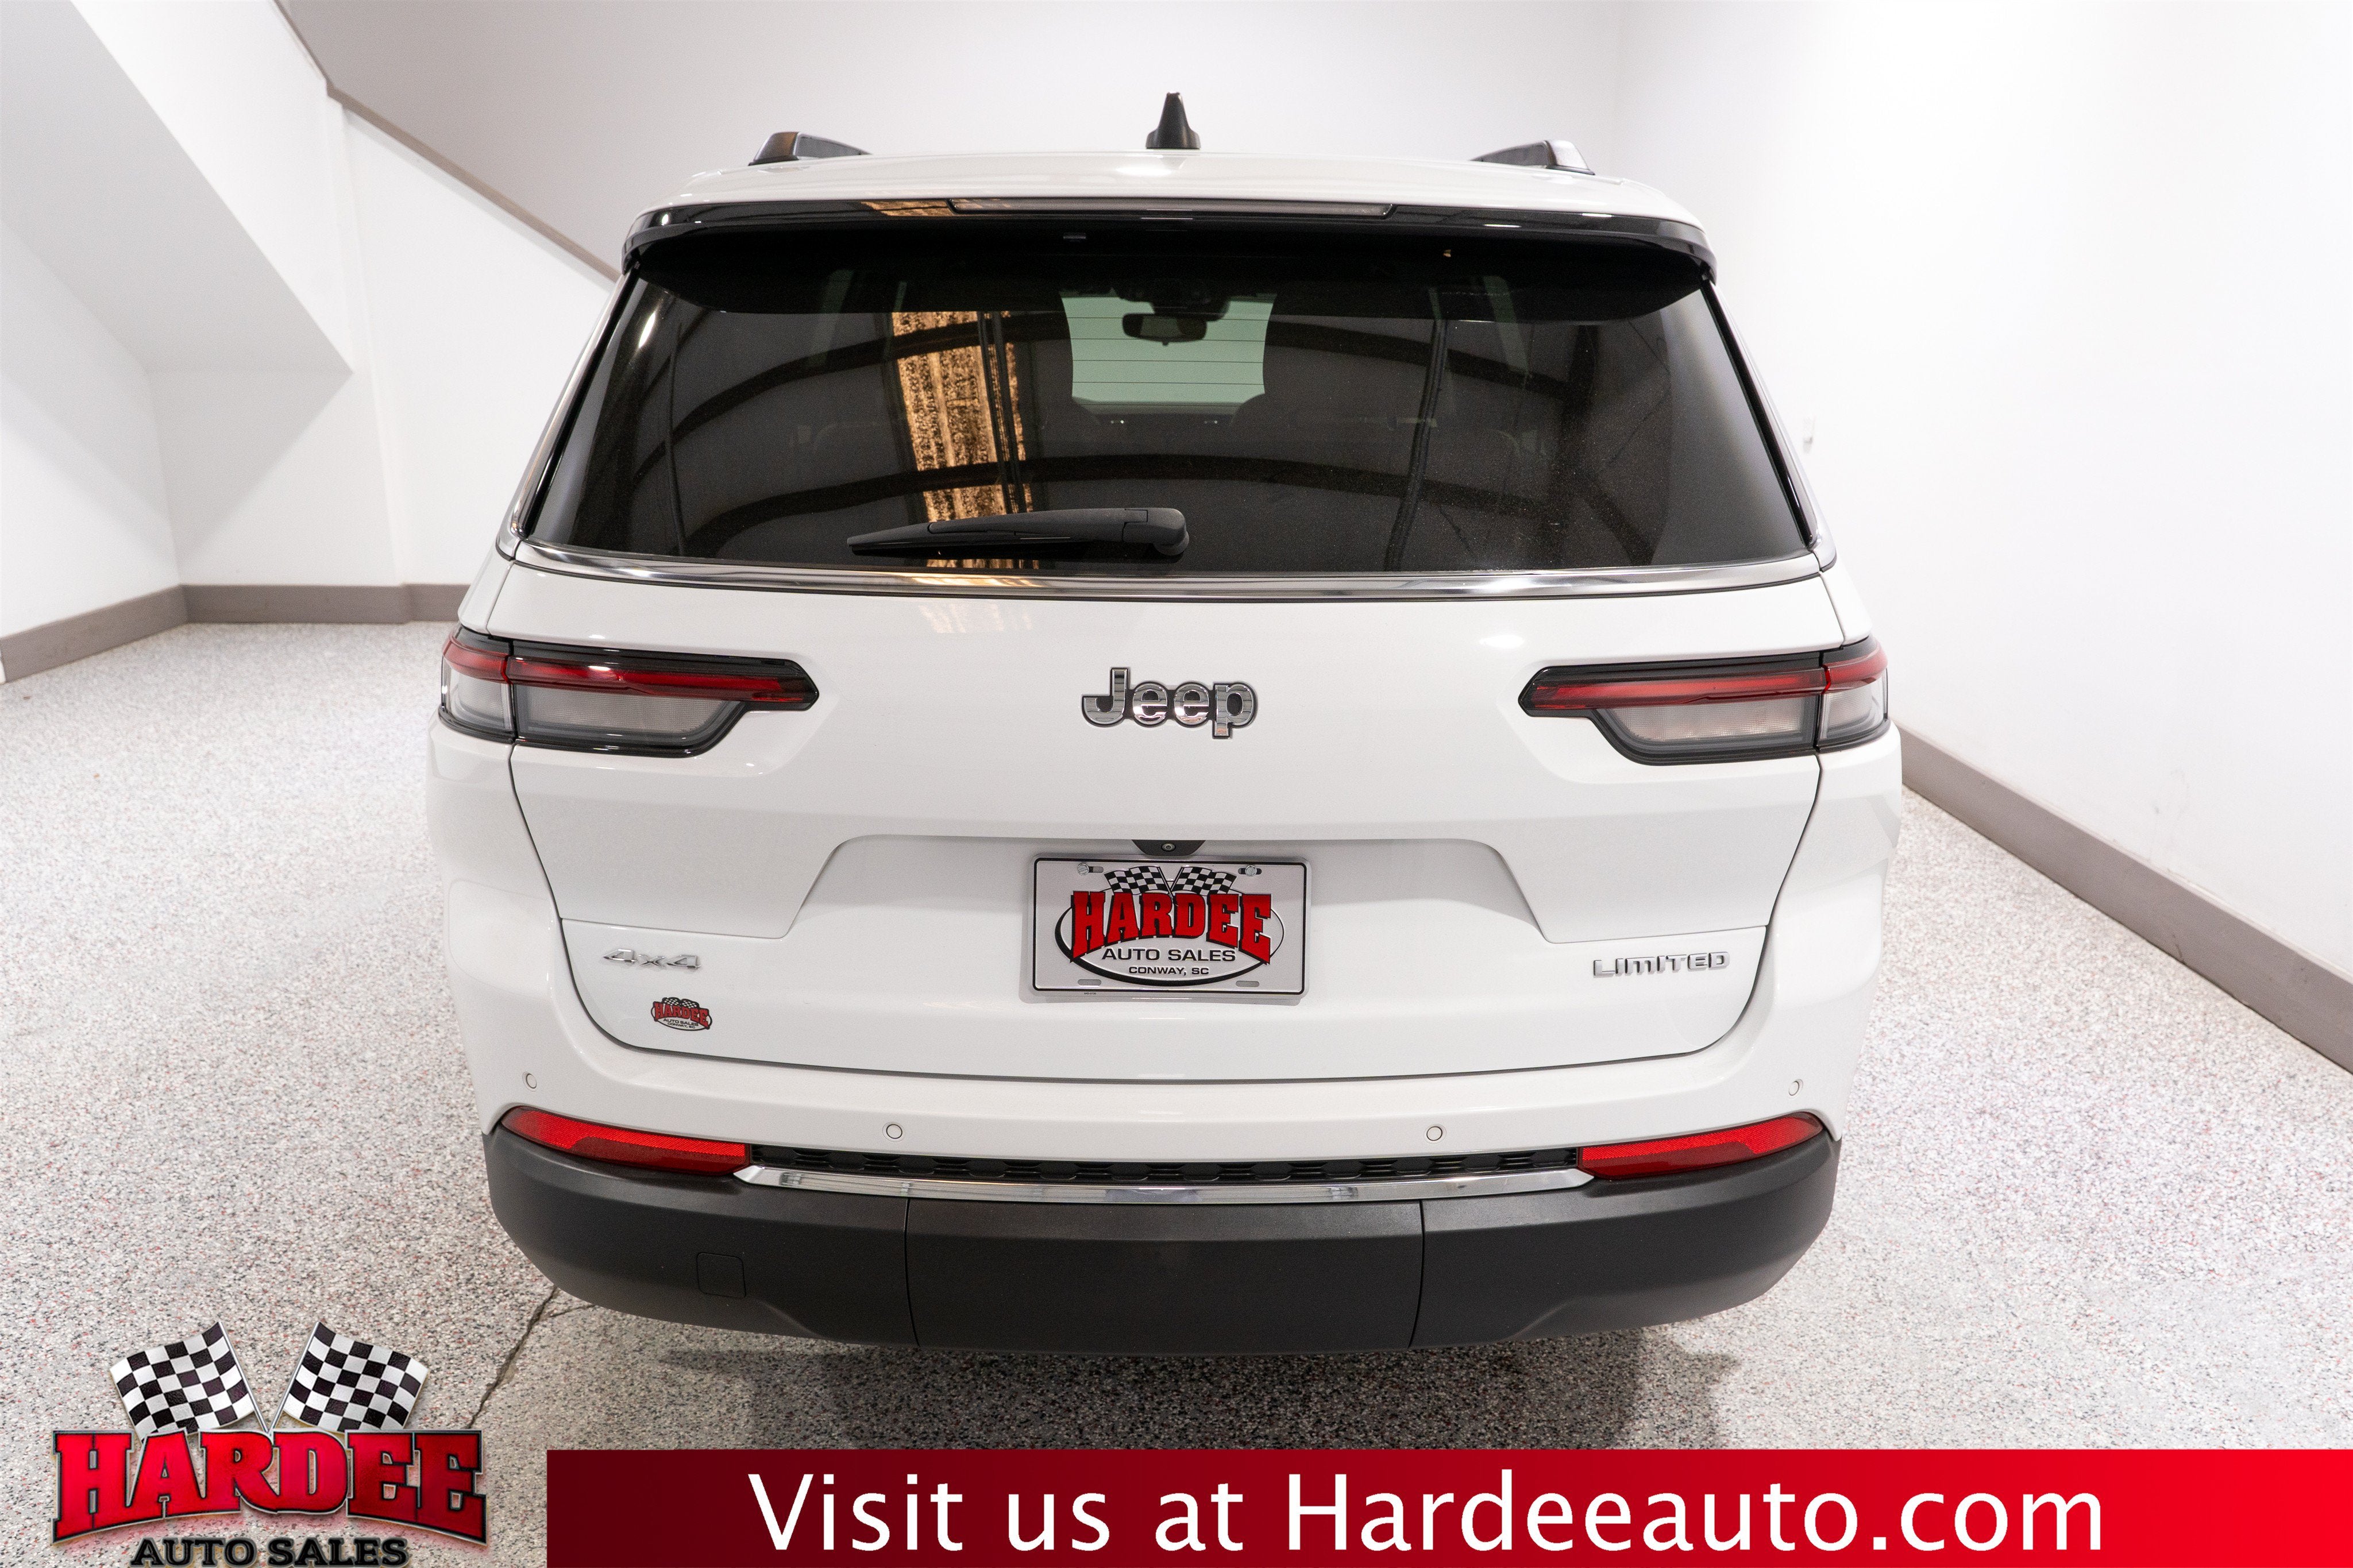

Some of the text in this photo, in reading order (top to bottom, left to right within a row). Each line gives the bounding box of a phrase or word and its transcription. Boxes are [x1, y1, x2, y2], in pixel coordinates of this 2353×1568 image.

[1082, 667, 1257, 739] Jeep
[1070, 891, 1272, 965] HARDEE
[1102, 948, 1236, 962] AUTO SALES
[1593, 952, 1730, 976] LIMITED
[1128, 966, 1209, 976] CONWAY, SC
[653, 1002, 709, 1029] HARDEE
